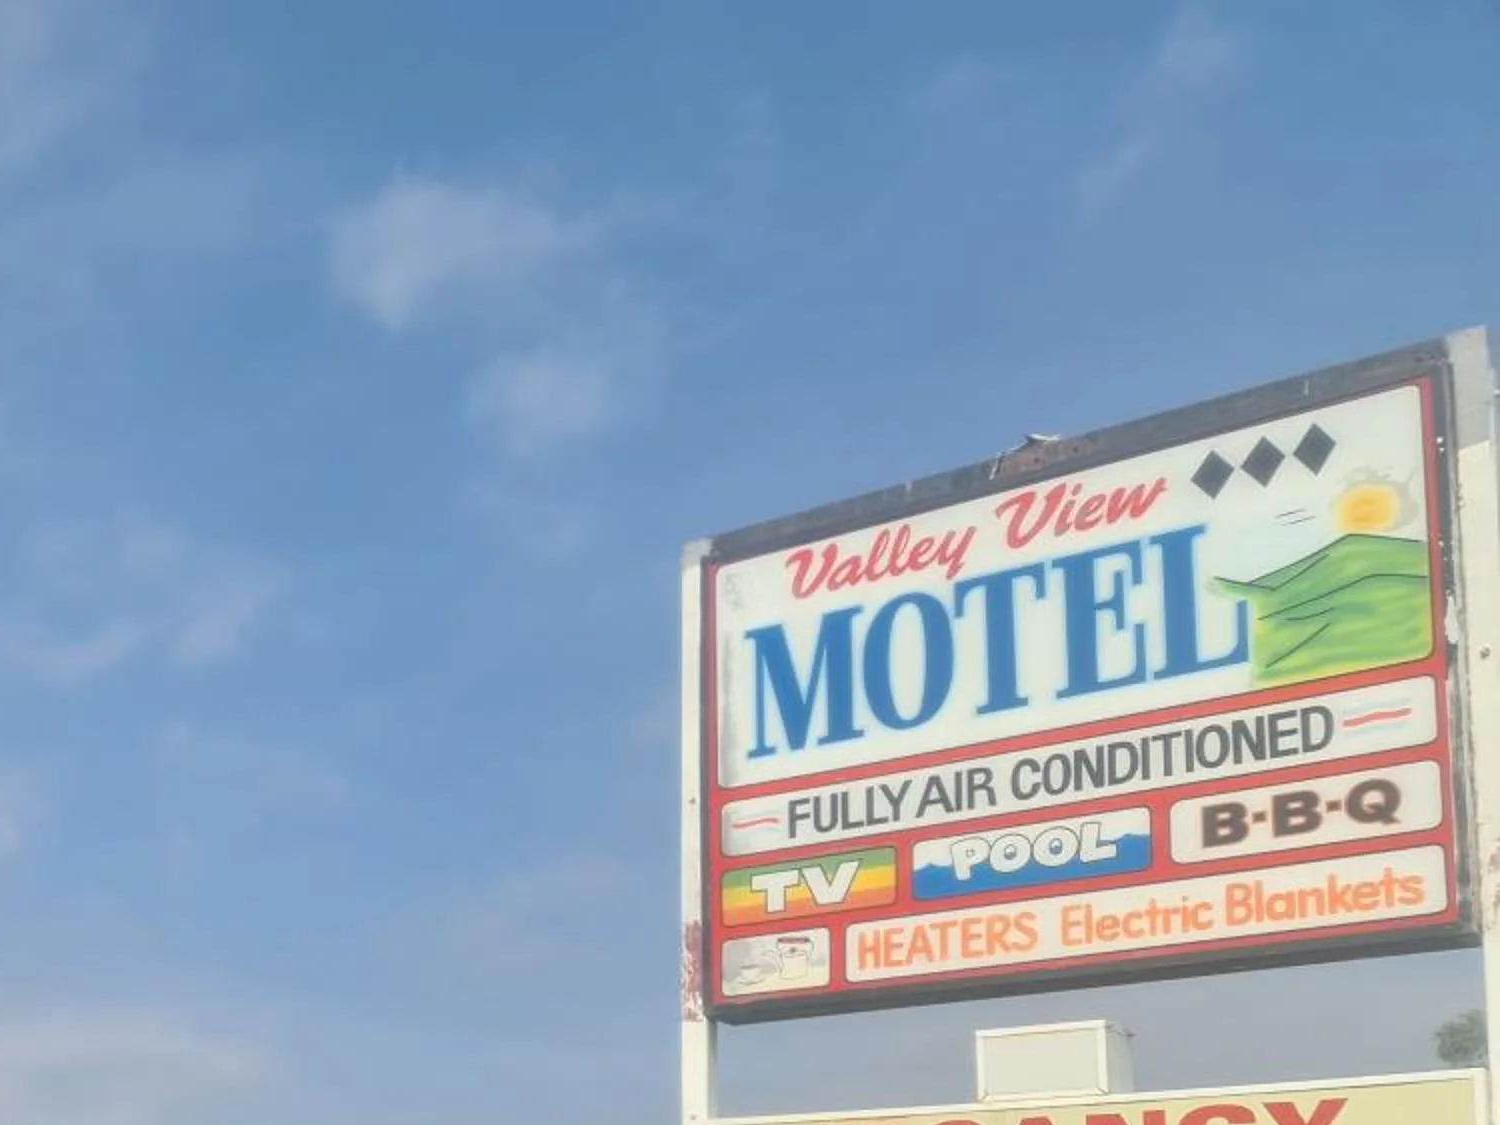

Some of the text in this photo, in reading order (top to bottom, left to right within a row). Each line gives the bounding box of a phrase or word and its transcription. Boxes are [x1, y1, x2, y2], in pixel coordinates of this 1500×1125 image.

[785, 476, 1168, 600] Valley View
[743, 524, 1249, 760] MOTEL
[787, 705, 1334, 839] FULLY AIR CONDITIONED
[750, 861, 863, 914] TV
[950, 822, 1119, 881] POOL
[857, 868, 1425, 971] HEATERS Electric Blankets
